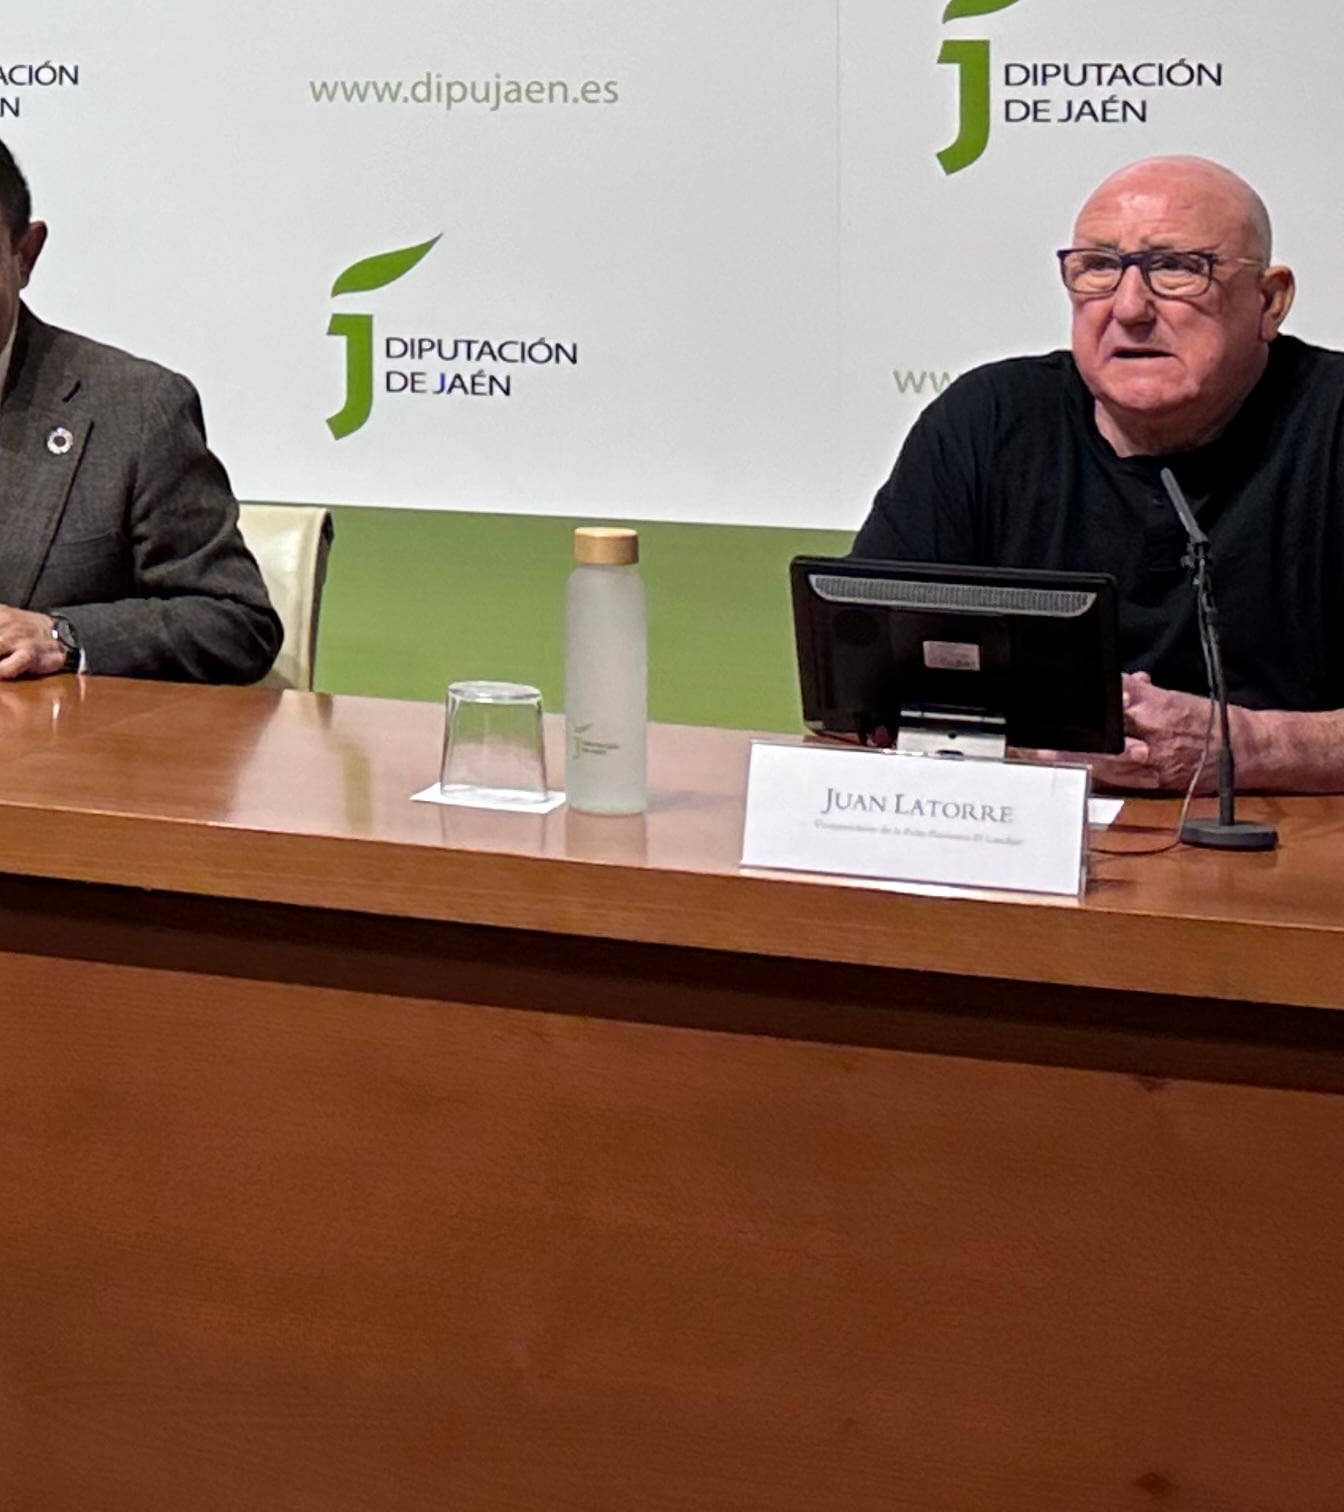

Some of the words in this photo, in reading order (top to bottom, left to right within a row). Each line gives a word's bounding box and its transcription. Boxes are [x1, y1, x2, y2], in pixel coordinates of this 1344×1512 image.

[1004, 58, 1223, 87] DIPUTACIÓN
[309, 71, 619, 112] www.dipujaen.es
[1004, 99, 1051, 123] DE
[1058, 95, 1147, 123] JAÉN
[385, 337, 578, 365] DIPUTACIÓN
[385, 370, 425, 394] DE
[434, 370, 511, 397] JAÉN
